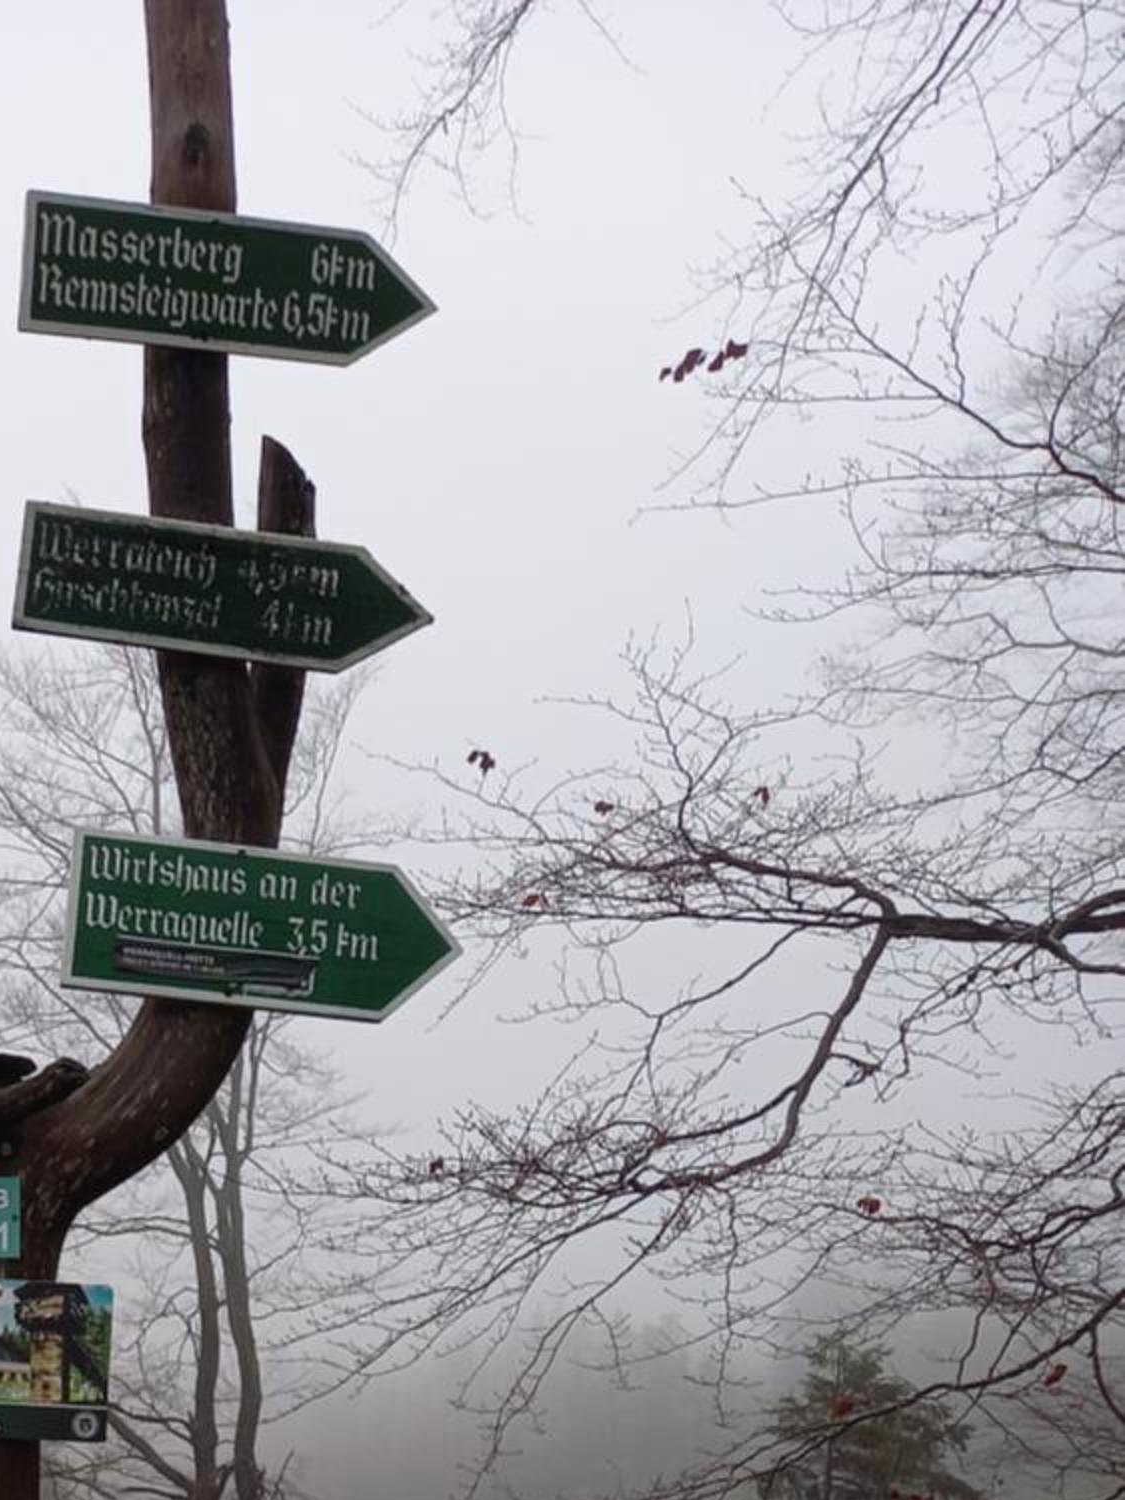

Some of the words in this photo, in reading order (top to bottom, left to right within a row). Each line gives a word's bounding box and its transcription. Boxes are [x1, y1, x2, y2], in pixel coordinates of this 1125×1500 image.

[39, 211, 244, 283] Masserberg
[39, 262, 278, 330] Rennsteigwarte
[89, 844, 248, 897] Wirtshaus
[259, 871, 297, 901] an
[310, 872, 362, 910] der
[85, 890, 265, 949] Werraquelle
